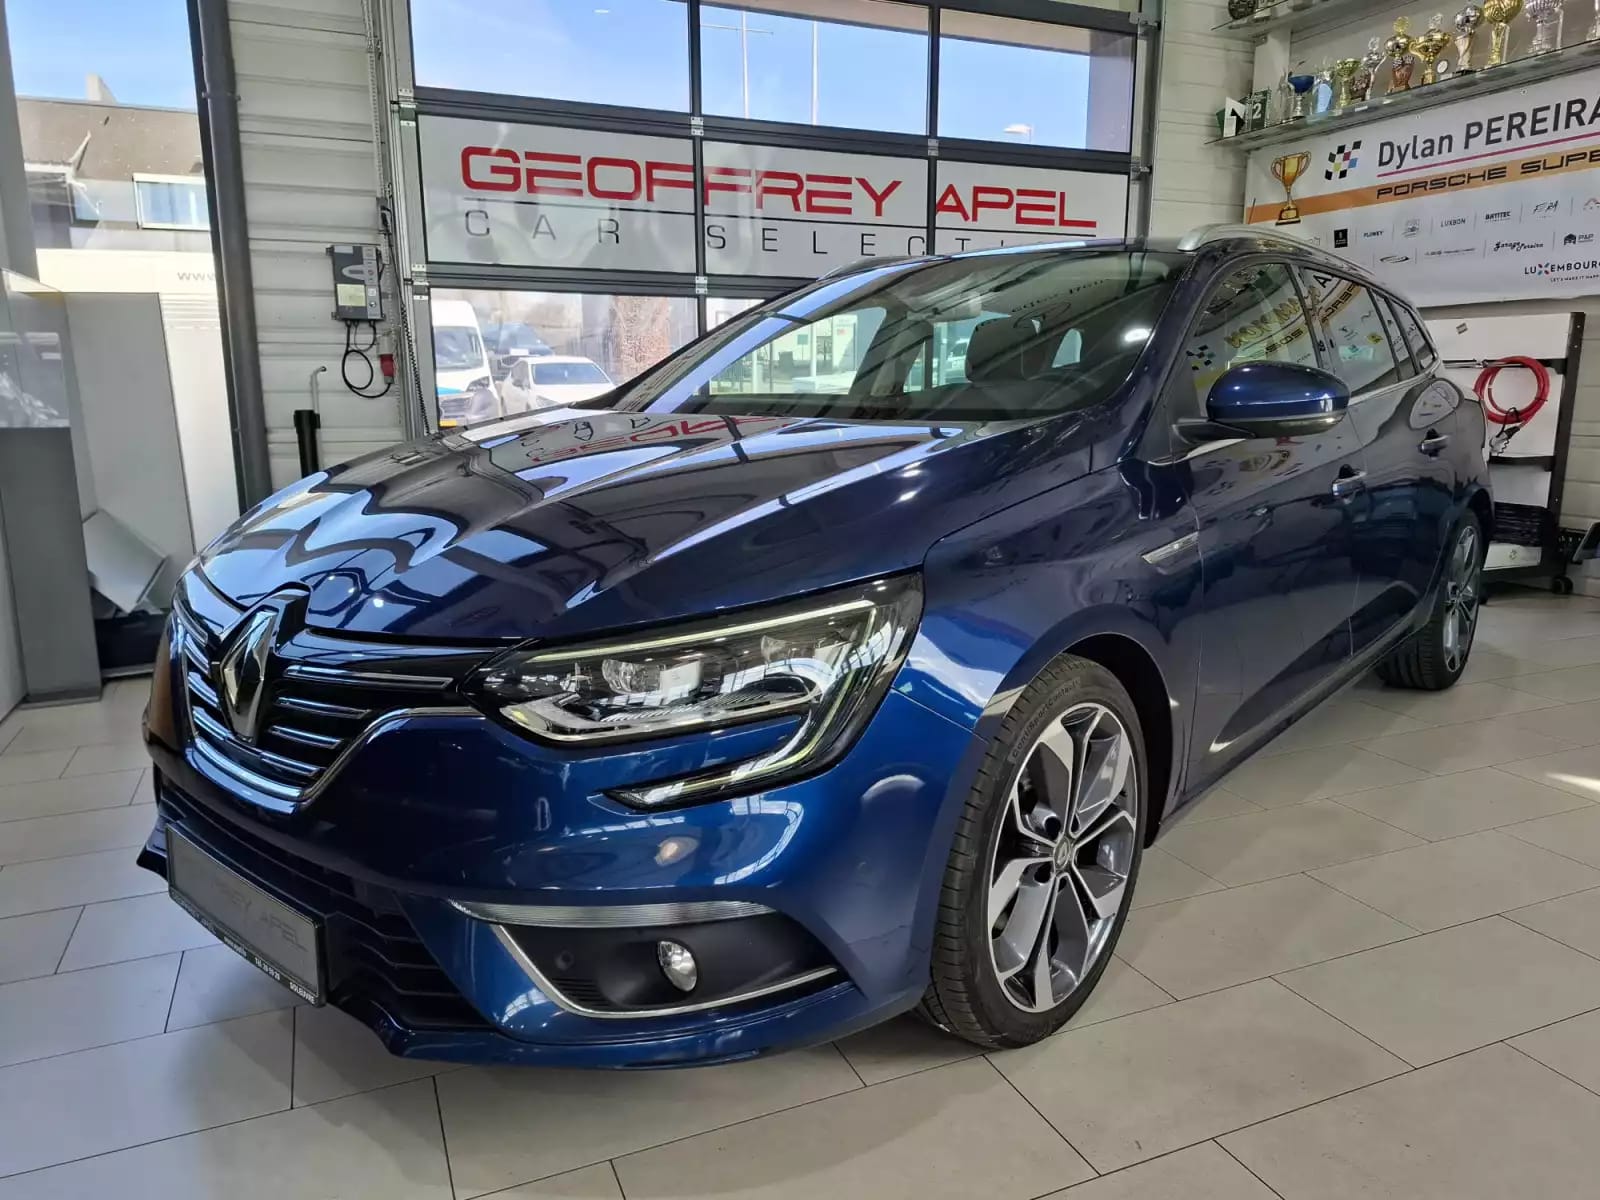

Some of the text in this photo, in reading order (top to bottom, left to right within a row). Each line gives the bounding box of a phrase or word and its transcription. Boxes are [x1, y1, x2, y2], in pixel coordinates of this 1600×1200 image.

[1252, 102, 1262, 119] 2
[1378, 134, 1453, 169] Dylan
[461, 146, 1097, 228] GEOFFREY APEL
[1376, 166, 1507, 200] PORSCHE
[465, 210, 620, 244] CAR
[1524, 260, 1600, 276] LUXEMBOUR
